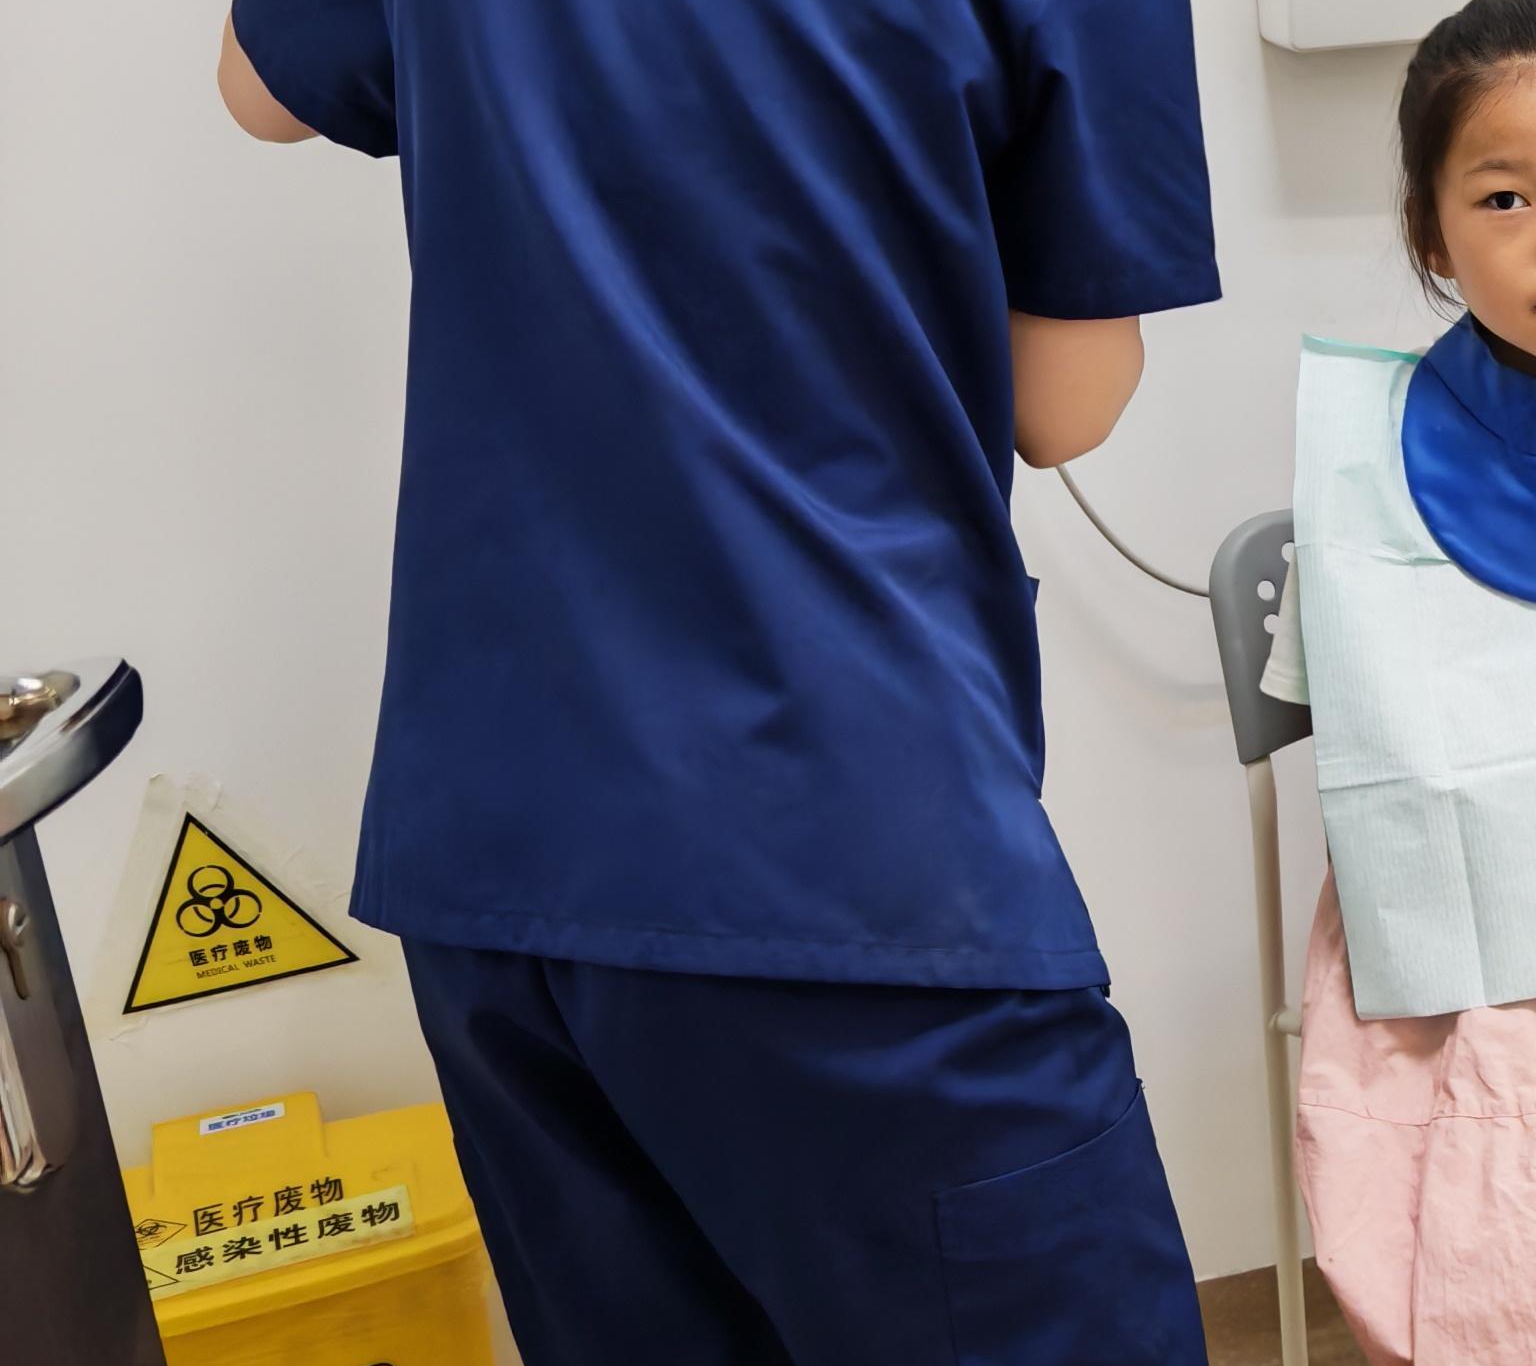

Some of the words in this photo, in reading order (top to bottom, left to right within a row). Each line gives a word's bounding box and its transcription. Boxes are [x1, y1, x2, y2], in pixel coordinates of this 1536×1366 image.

[189, 935, 272, 966] 医疗废物
[197, 964, 240, 979] MEDICAL
[243, 955, 276, 968] WASTE
[193, 1177, 344, 1237] 医疗废物
[176, 1202, 400, 1274] 感染性废物
